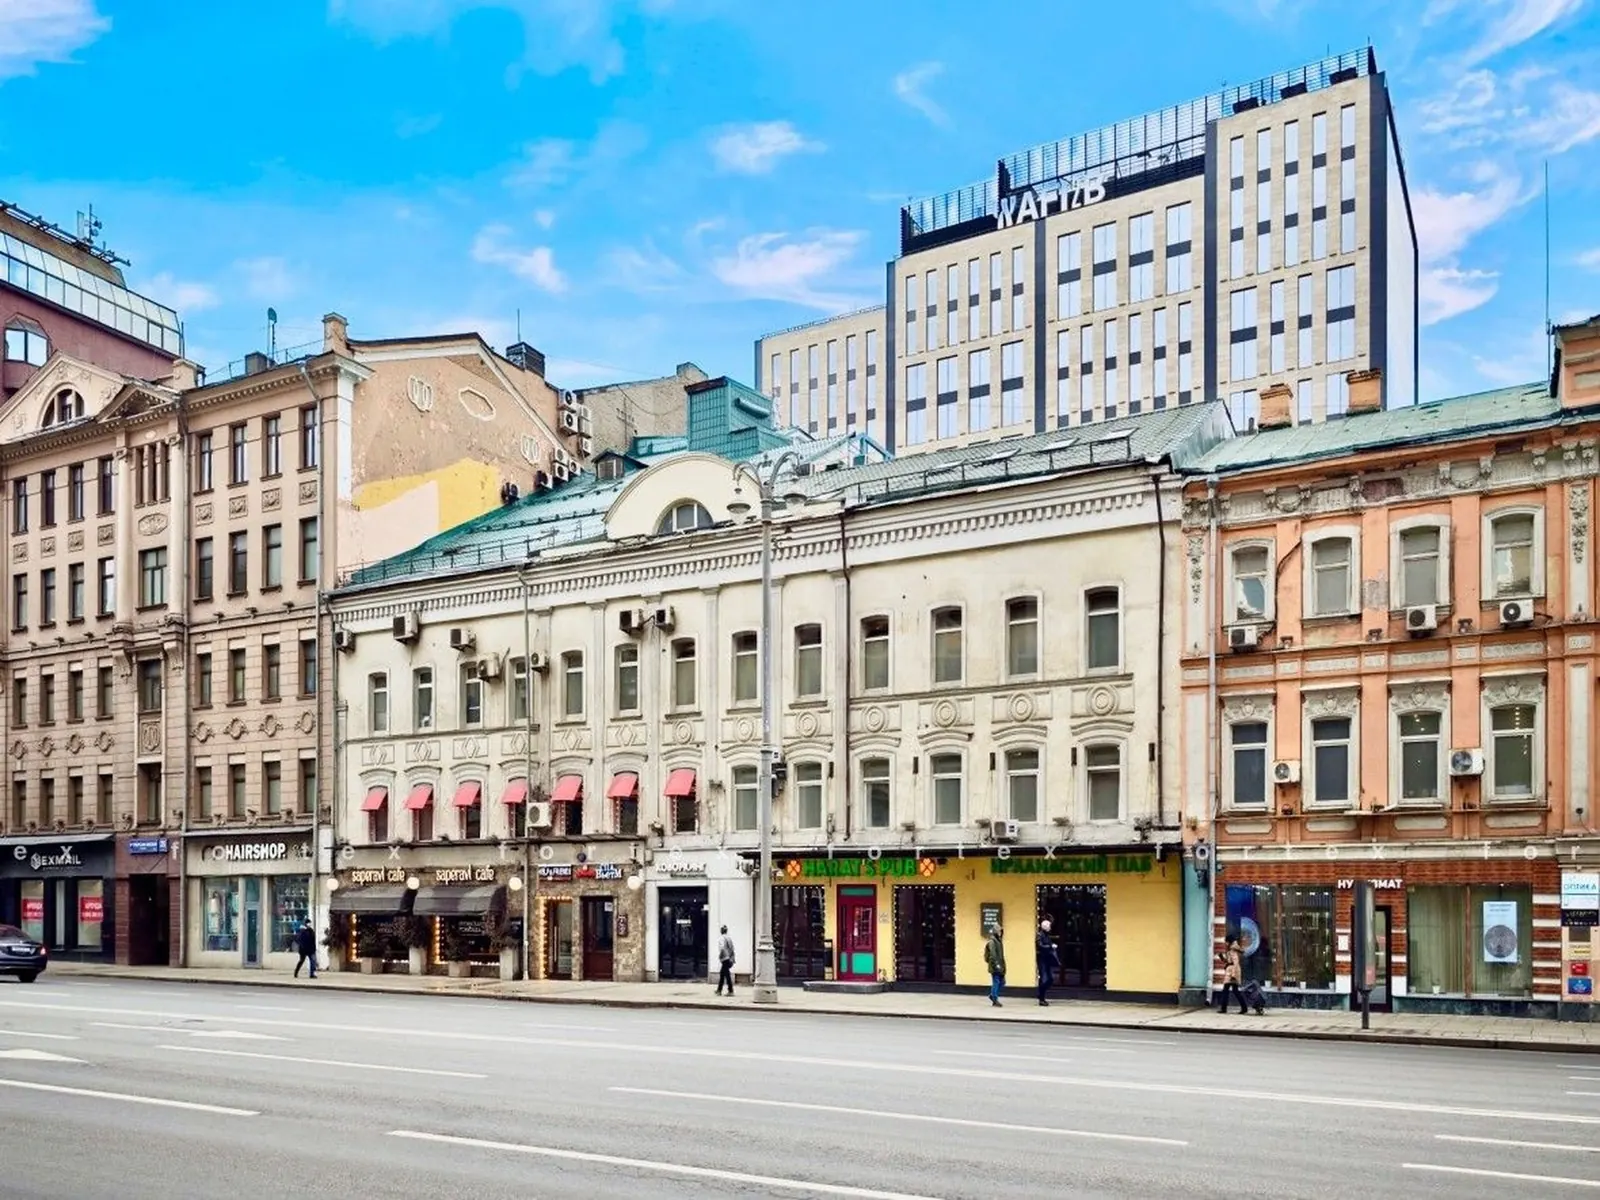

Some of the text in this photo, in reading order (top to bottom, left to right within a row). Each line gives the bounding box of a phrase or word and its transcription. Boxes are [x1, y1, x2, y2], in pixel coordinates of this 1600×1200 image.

[41, 854, 82, 866] EXMAIL
[803, 857, 918, 877] HARAT'S PUB
[351, 866, 406, 884] saperavi cafe
[435, 865, 495, 884] saperavi cafe
